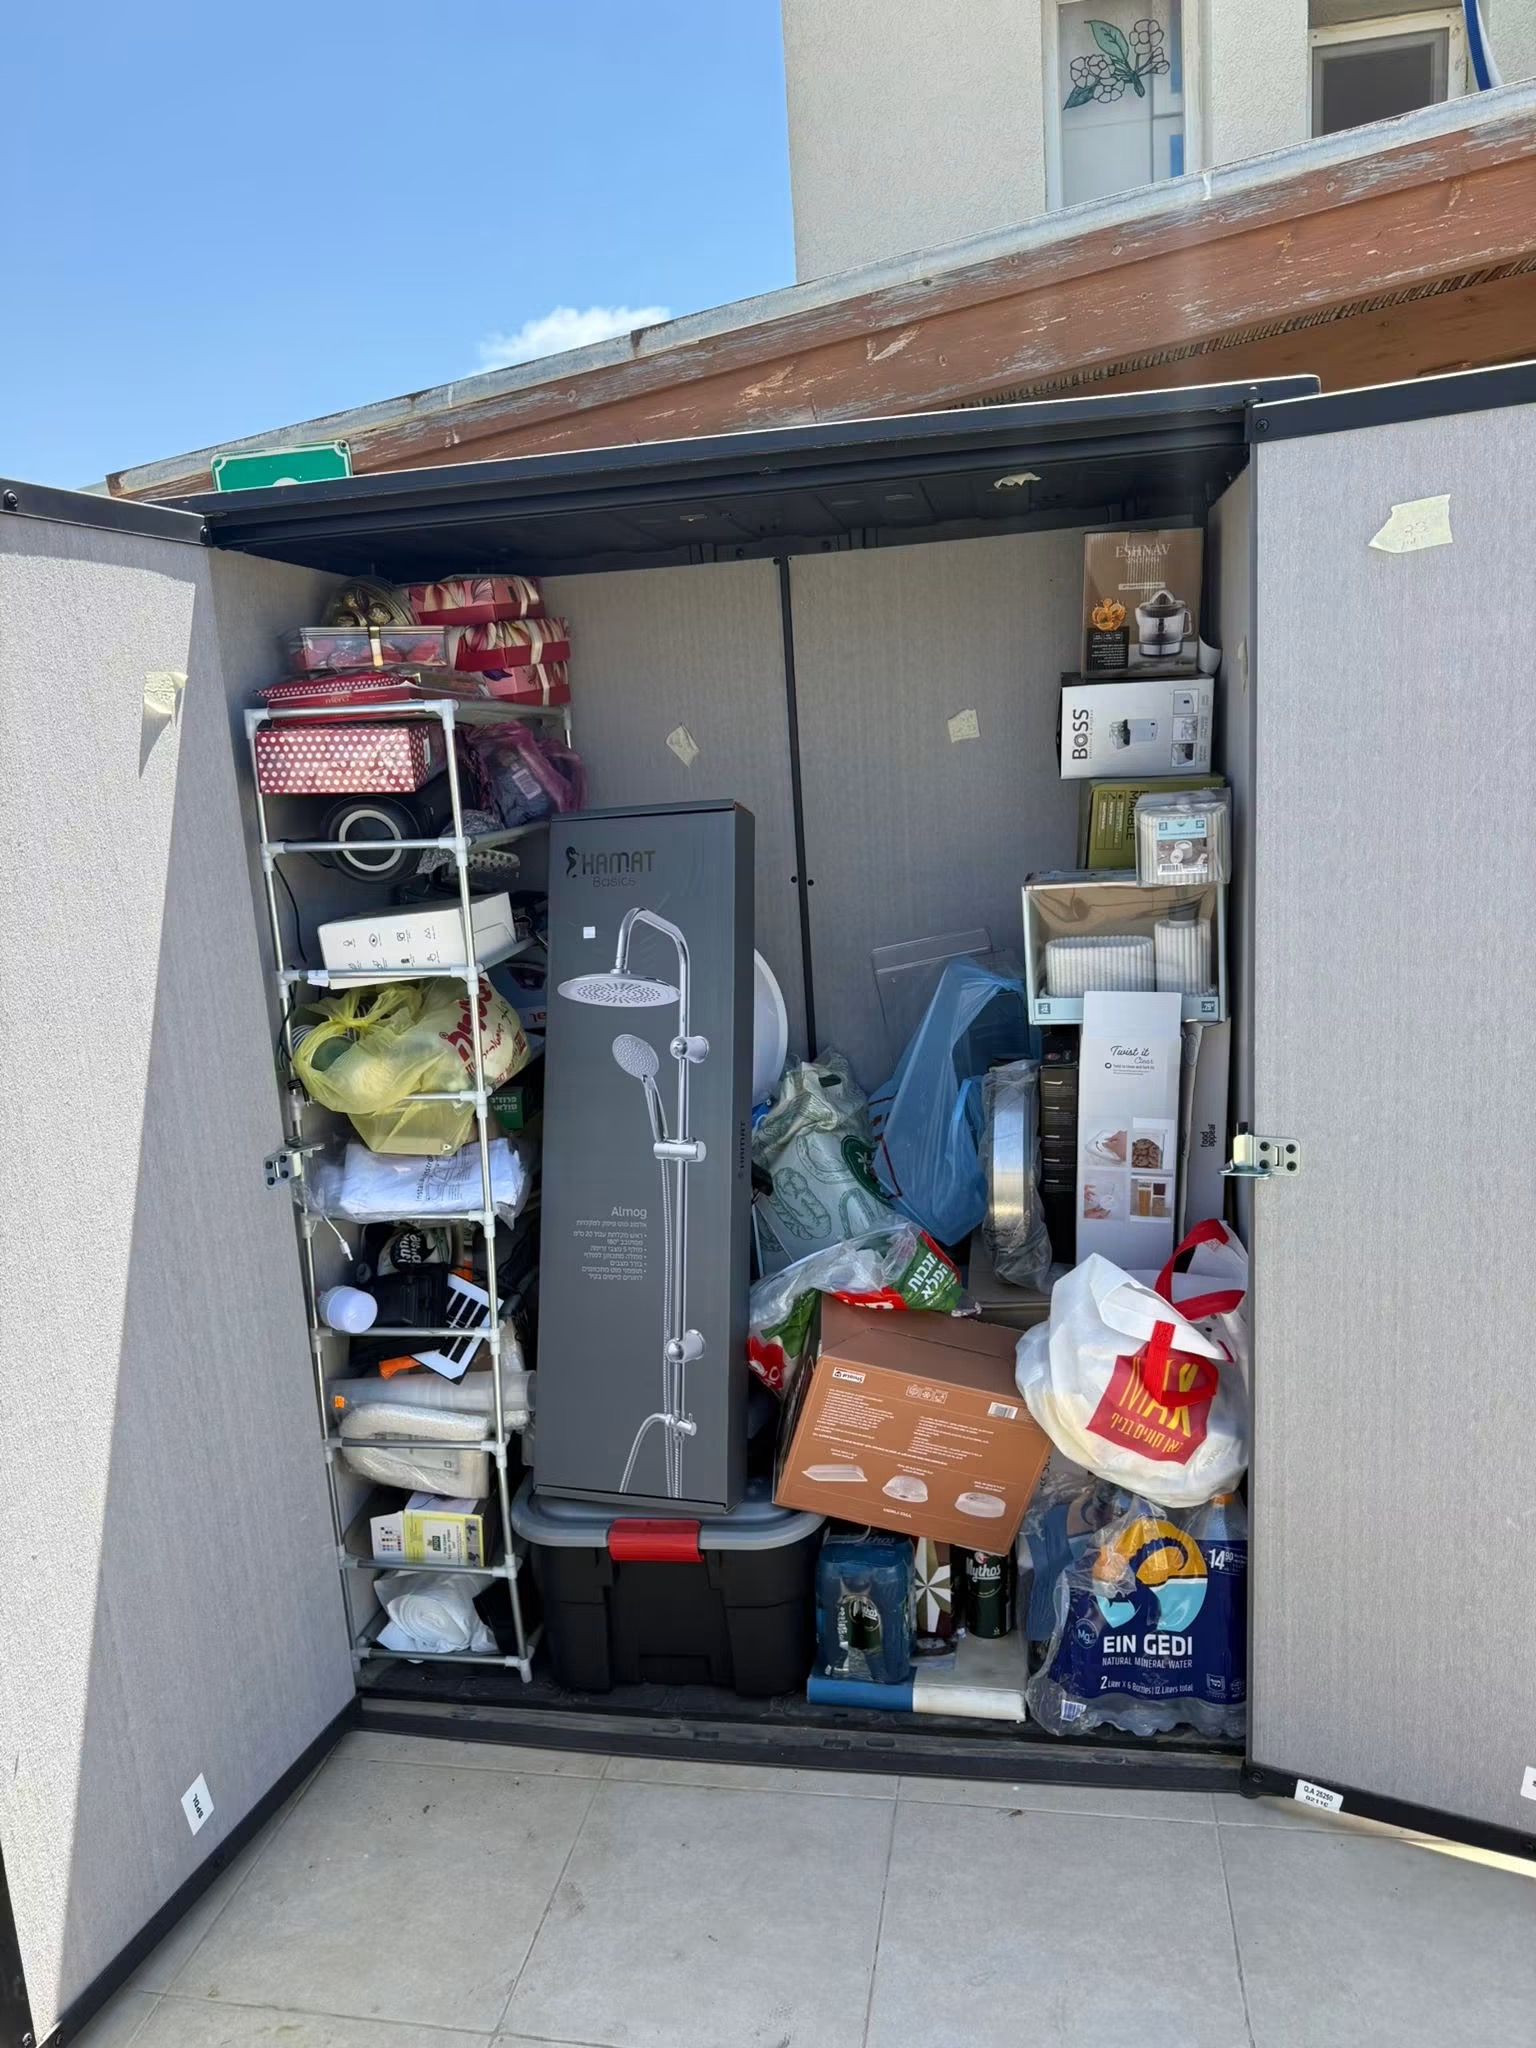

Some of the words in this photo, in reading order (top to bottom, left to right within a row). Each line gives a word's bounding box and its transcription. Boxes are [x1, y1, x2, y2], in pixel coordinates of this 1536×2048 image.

[1072, 709, 1089, 760] BOSS
[1126, 790, 1139, 840] MARBLE
[582, 850, 656, 874] HAMAT
[592, 876, 636, 888] Basics
[1110, 1046, 1138, 1056] Twist
[1141, 1048, 1150, 1056] it
[1200, 1132, 1208, 1148] food
[1208, 1124, 1216, 1147] appeal
[611, 1206, 648, 1219] Almog
[921, 1262, 950, 1300] הפלא
[1110, 1412, 1134, 1436] בכיף
[966, 1558, 1000, 1580] Mythos
[1103, 1634, 1136, 1654] EIN
[1144, 1634, 1192, 1656] GEDI
[1102, 1657, 1132, 1666] NATURAL
[1134, 1658, 1165, 1668] MINERAL
[1168, 1659, 1192, 1668] WATER
[1100, 1676, 1107, 1690] 2
[1127, 1681, 1132, 1690] 6
